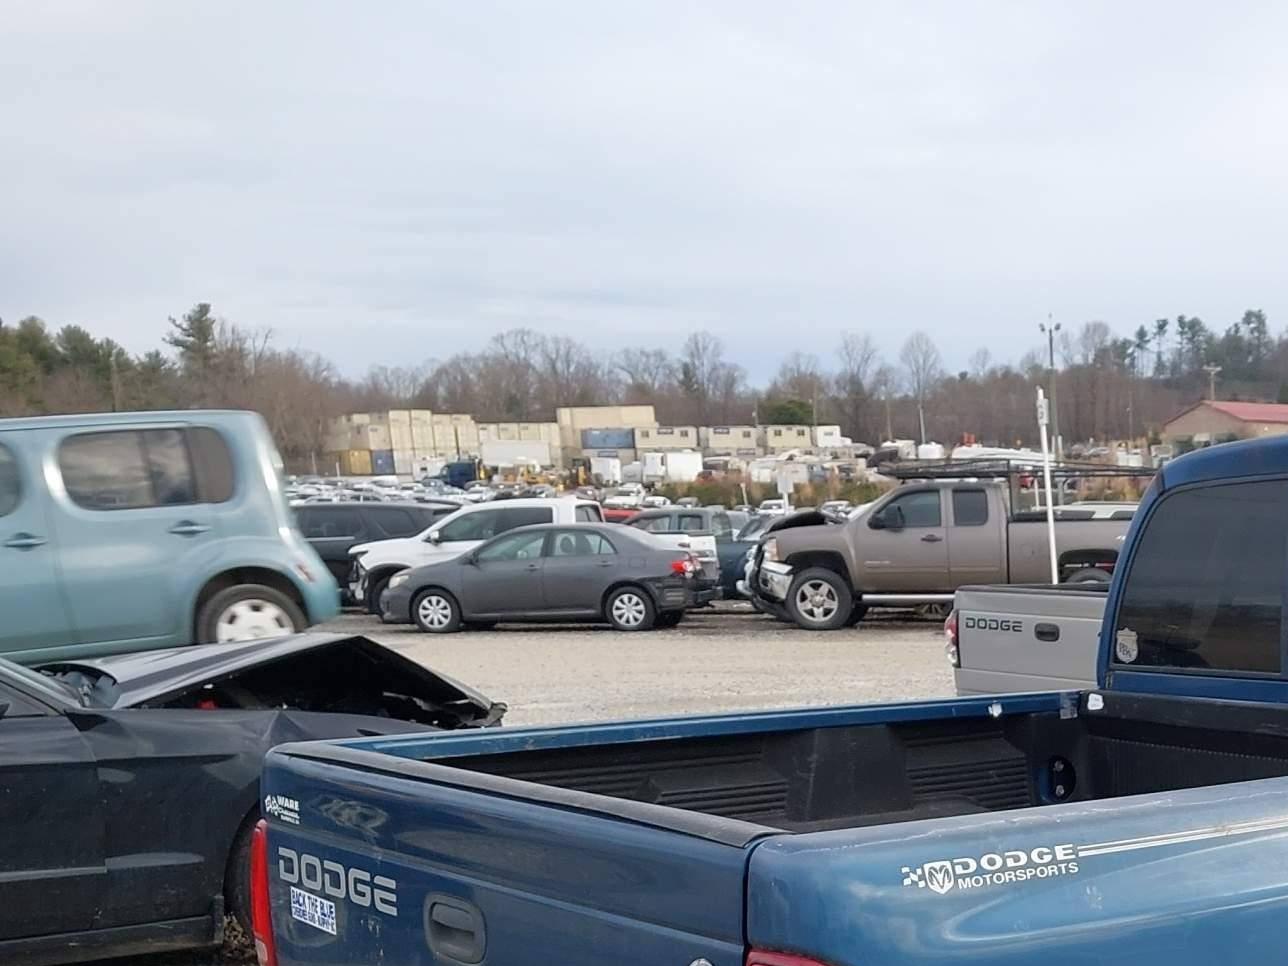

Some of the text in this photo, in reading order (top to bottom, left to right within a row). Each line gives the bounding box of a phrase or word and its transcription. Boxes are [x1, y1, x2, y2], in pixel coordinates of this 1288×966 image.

[965, 617, 1023, 633] DODGE
[276, 794, 300, 811] WARE
[952, 843, 1077, 875] DODGE
[277, 846, 398, 917] DODGE
[957, 862, 1080, 890] MOTORSPORTS
[307, 895, 318, 914] THE
